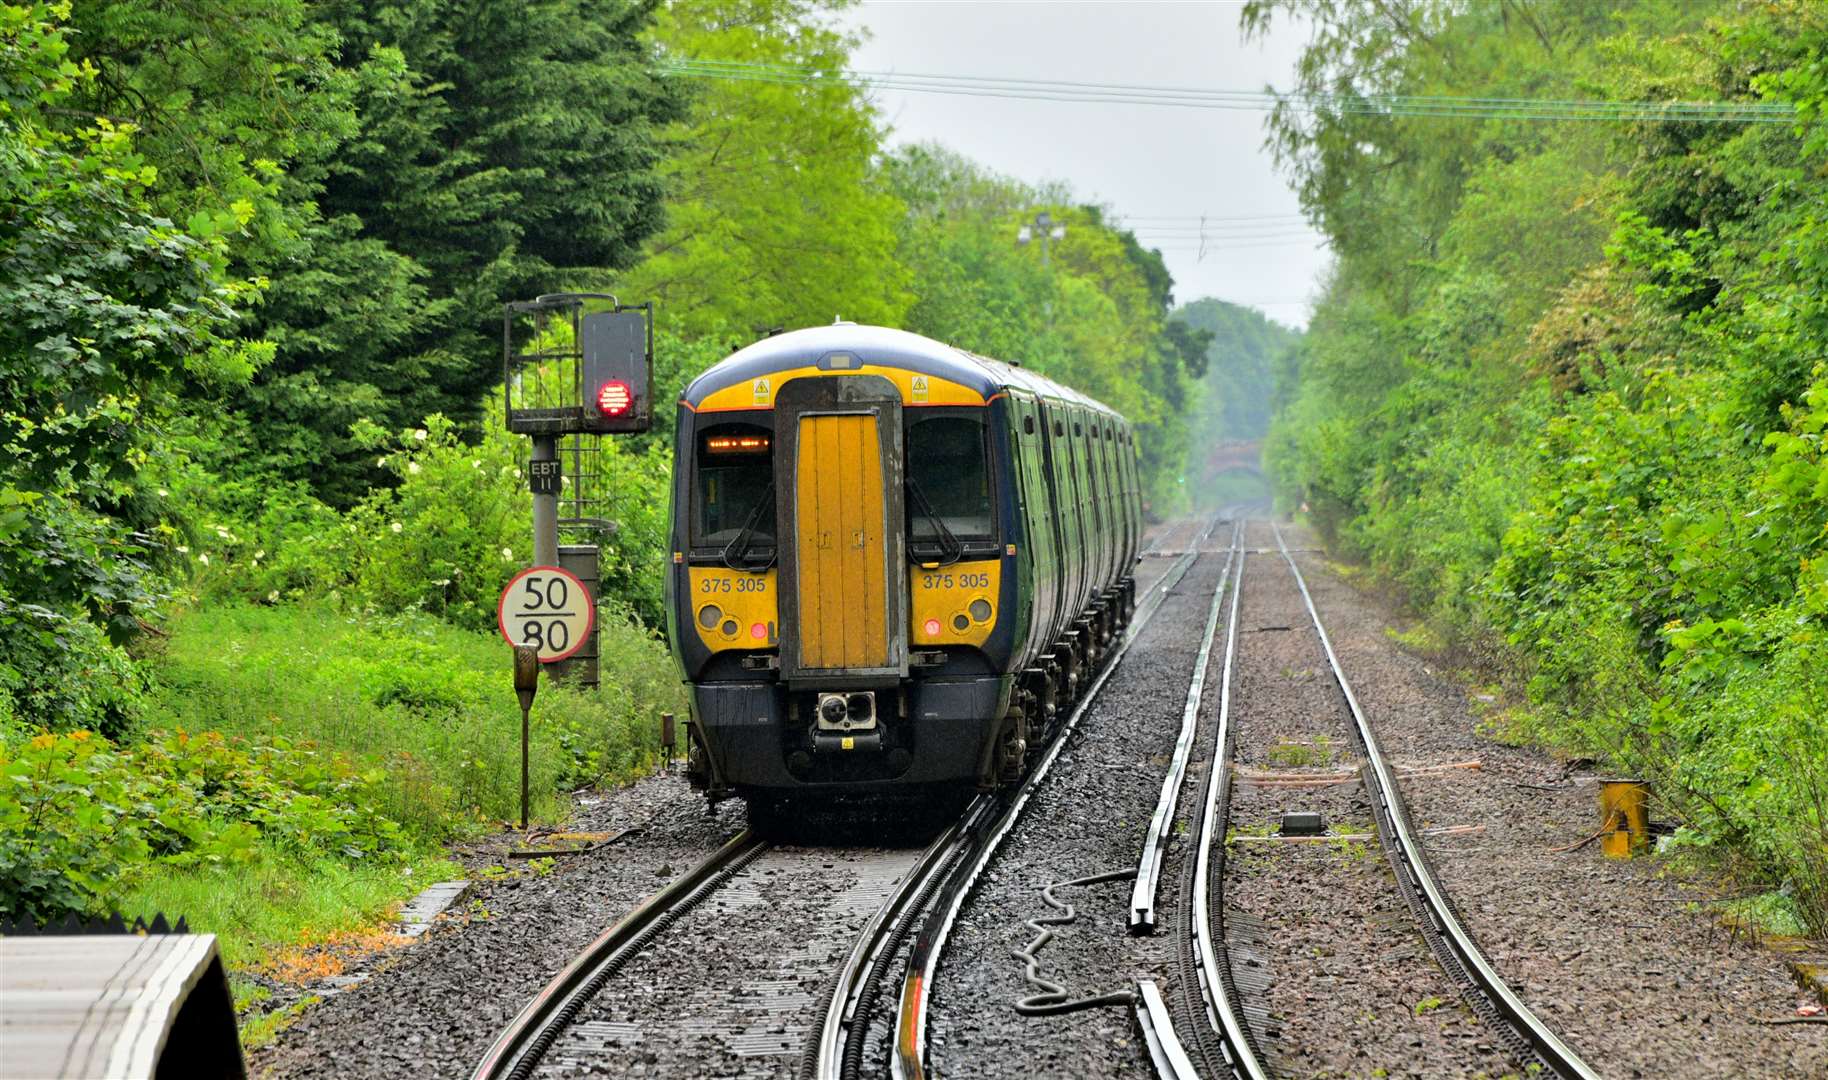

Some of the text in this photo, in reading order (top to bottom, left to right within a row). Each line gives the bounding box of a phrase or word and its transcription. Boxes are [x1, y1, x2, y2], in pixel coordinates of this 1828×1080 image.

[531, 463, 558, 475] EBT
[701, 578, 766, 592] 375 305
[923, 573, 989, 589] 375 305
[523, 577, 568, 610] 50
[523, 620, 569, 652] 80
